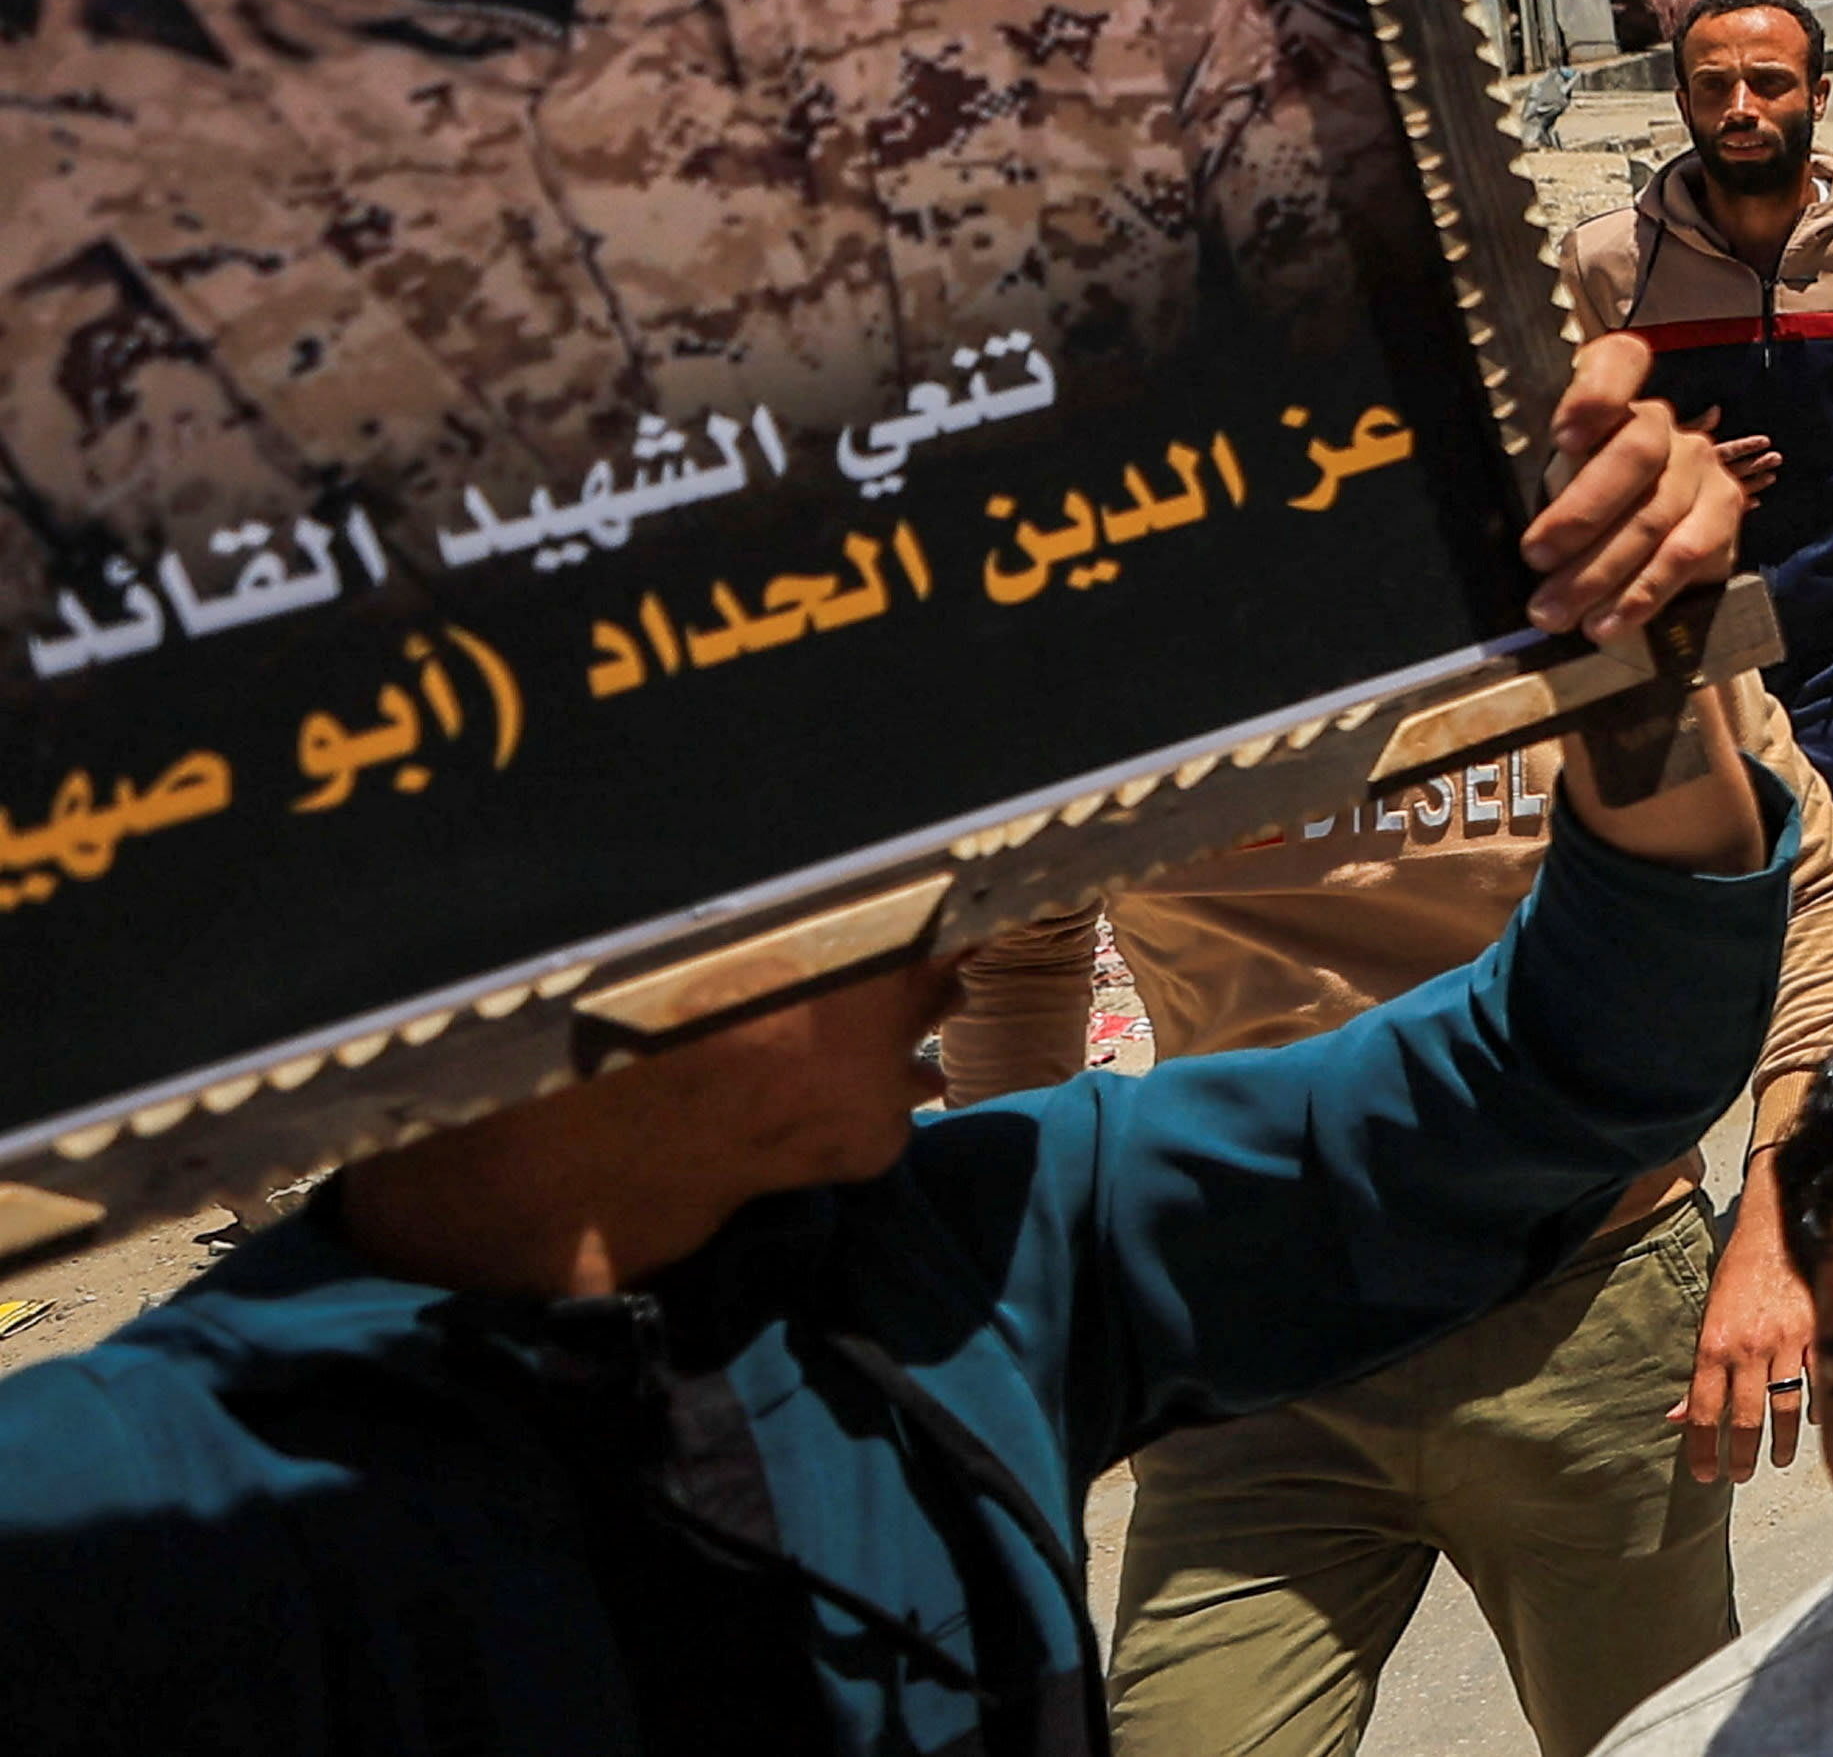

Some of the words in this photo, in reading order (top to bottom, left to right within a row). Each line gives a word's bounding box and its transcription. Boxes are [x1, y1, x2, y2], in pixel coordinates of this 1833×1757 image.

[436, 402, 788, 575] الشهيد
[834, 325, 1058, 498] تنعي
[1286, 399, 1417, 514] عز
[29, 505, 388, 679] القائد
[981, 429, 1249, 608] الدين
[585, 520, 934, 702] الحداد
